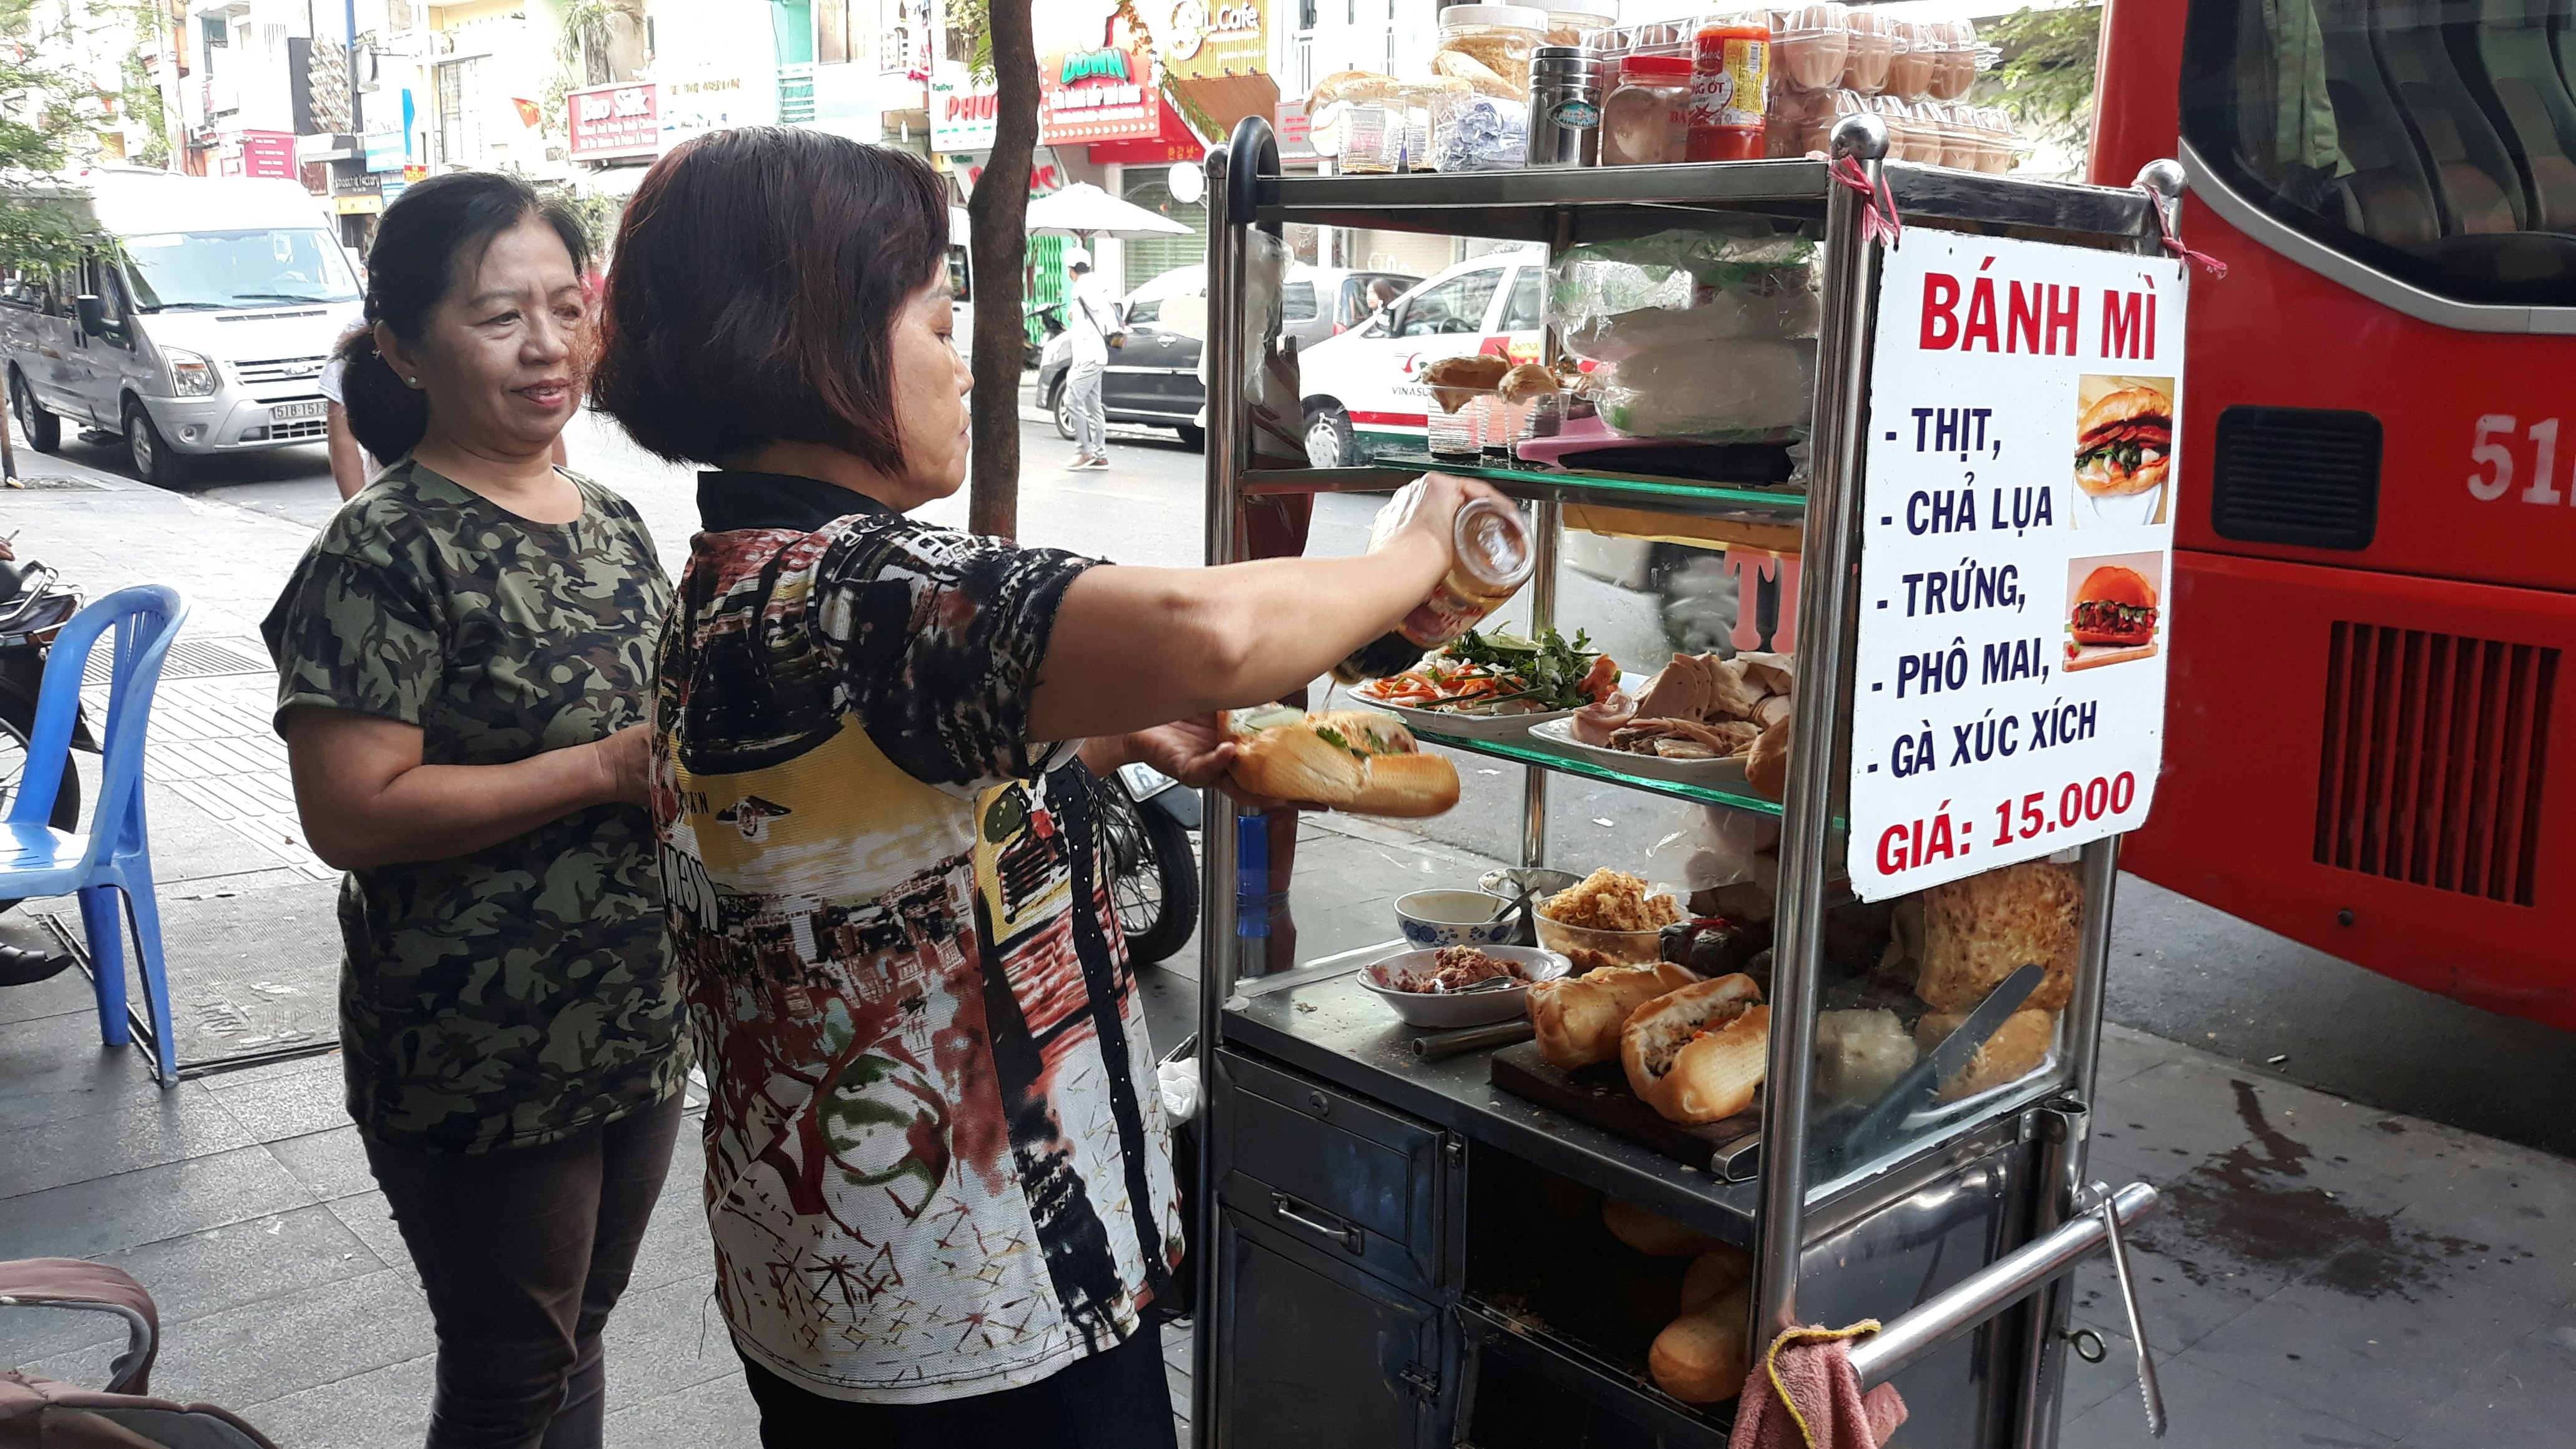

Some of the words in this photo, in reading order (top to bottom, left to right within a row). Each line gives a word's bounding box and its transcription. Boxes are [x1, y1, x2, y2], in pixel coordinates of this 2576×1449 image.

[1061, 48, 1131, 85] DOWN
[945, 92, 998, 122] PHÚ
[1918, 255, 2080, 356] BÁNH
[2100, 275, 2157, 360] MÌ
[1911, 407, 2001, 462] THỊT,
[1906, 471, 1977, 535] CHẢ
[1991, 485, 2053, 537] LỤA
[1901, 556, 2026, 618] TRỨNG,
[1896, 636, 1968, 699] PHÔ
[1981, 637, 2050, 686] MAI,
[1891, 720, 1936, 779] GÀ
[1949, 708, 2019, 767] XÚC
[2028, 696, 2098, 751] XÍCH
[1875, 798, 1973, 876] GIÁ:
[1992, 770, 2135, 847] 15.000
